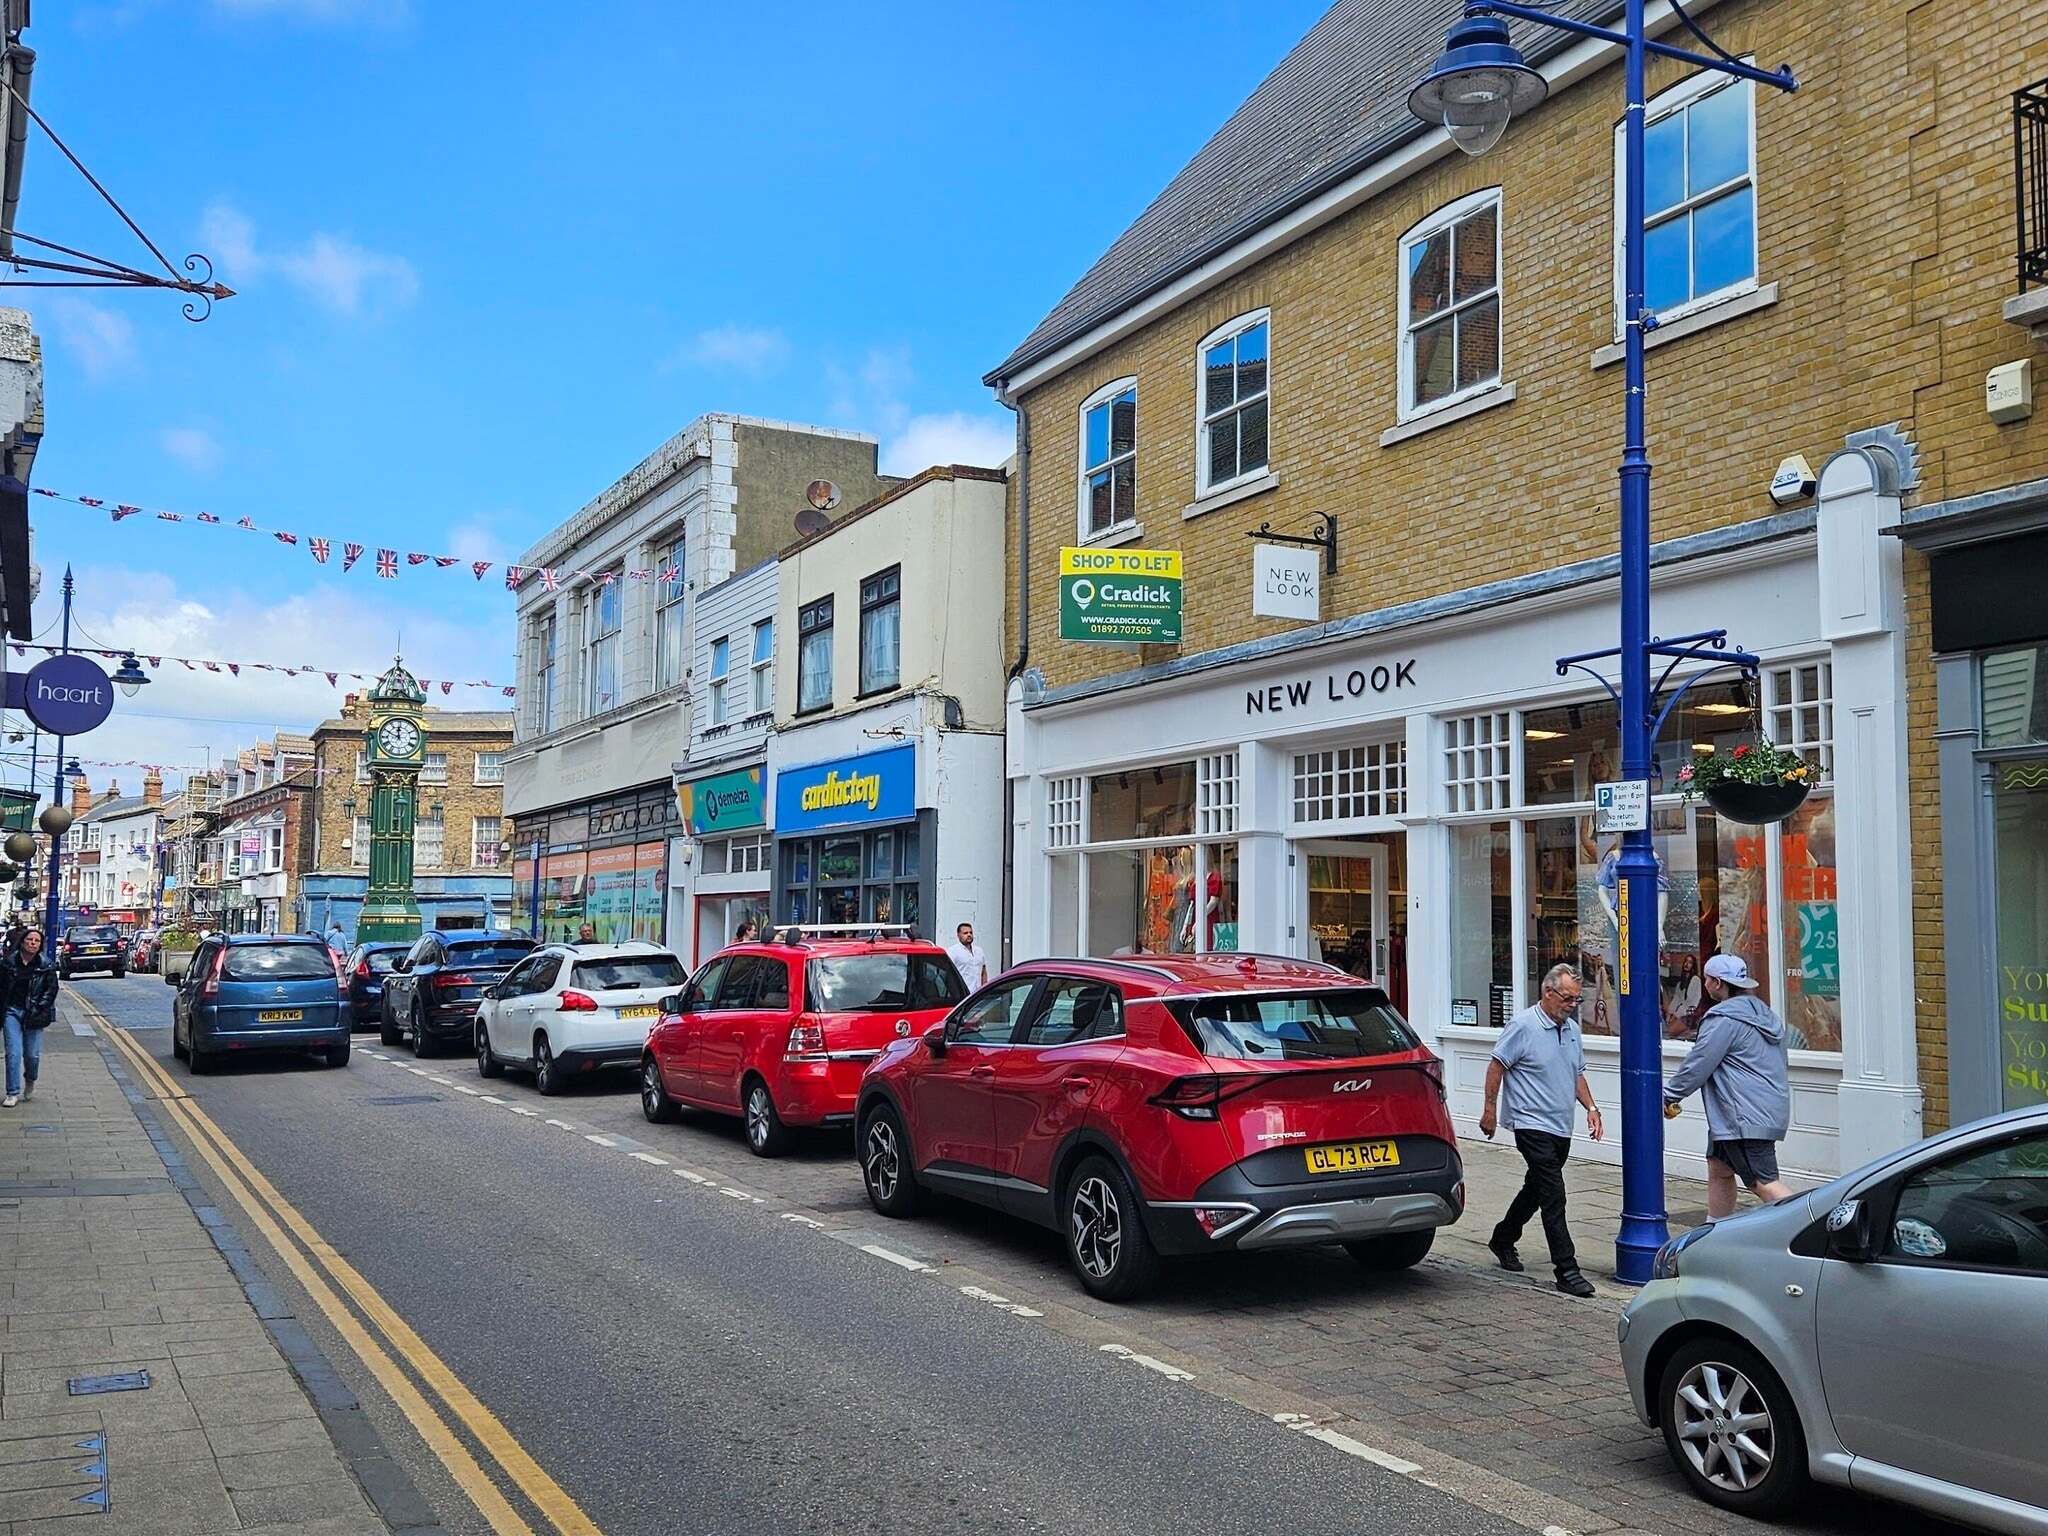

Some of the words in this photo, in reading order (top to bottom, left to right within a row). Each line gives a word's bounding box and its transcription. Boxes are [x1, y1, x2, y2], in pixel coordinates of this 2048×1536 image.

[1072, 554, 1115, 569] SHOP
[1118, 555, 1141, 570] TO
[1145, 556, 1172, 571] LET
[1270, 567, 1311, 583] NEW
[1100, 584, 1171, 602] Cradick
[1266, 581, 1314, 599] LOOK
[1080, 616, 1161, 625] WWW.CRADICK.CO.UK
[1091, 624, 1118, 633] 01892
[1120, 625, 1152, 634] 707505
[37, 678, 103, 705] haart
[1246, 680, 1312, 715] NEW
[1328, 658, 1416, 702] LOOK
[718, 786, 750, 808] demelza
[801, 771, 880, 811] cardfactory
[1601, 790, 1610, 804] P
[1620, 884, 1629, 990] EHDV019
[1814, 931, 1836, 949] 25
[262, 1011, 281, 1020] KR13
[282, 1010, 300, 1019] KWG
[621, 1006, 644, 1018] HY64
[2007, 1062, 2048, 1098] St
[1257, 1131, 1307, 1142] SPORTAGE
[1312, 1148, 1357, 1168] GL73
[1359, 1144, 1392, 1164] RCZ
